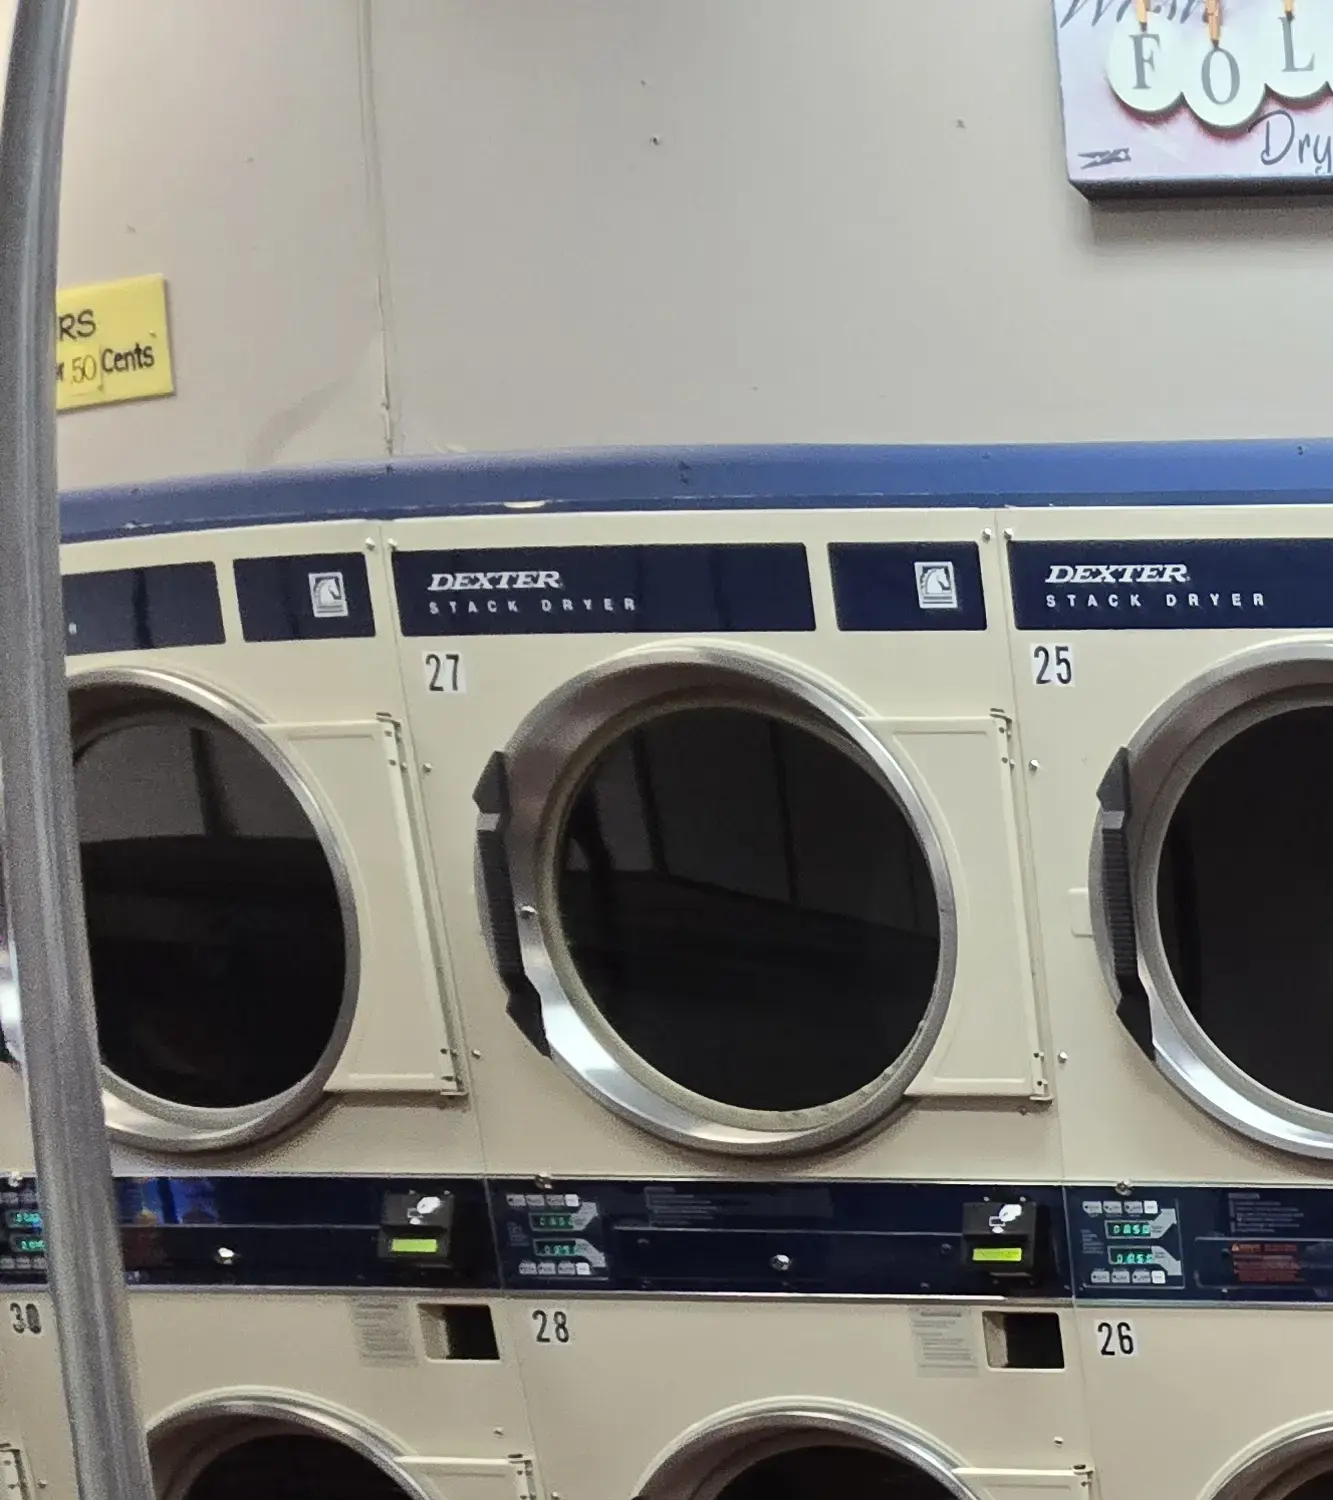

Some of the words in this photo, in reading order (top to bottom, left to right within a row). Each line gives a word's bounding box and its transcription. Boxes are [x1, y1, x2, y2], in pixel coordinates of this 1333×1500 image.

[1248, 109, 1332, 174] Dry
[101, 342, 155, 373] Cents
[427, 570, 562, 590] DEXTER
[1044, 564, 1188, 584] DEXTER
[429, 599, 518, 615] STACK
[541, 597, 636, 612] DRYER
[1045, 593, 1142, 608] STACK
[1166, 593, 1265, 608] DRYER
[425, 653, 460, 692] 27
[1034, 645, 1073, 685] 25
[9, 1302, 42, 1335] 30
[531, 1309, 570, 1344] 28
[1097, 1321, 1135, 1357] 26
